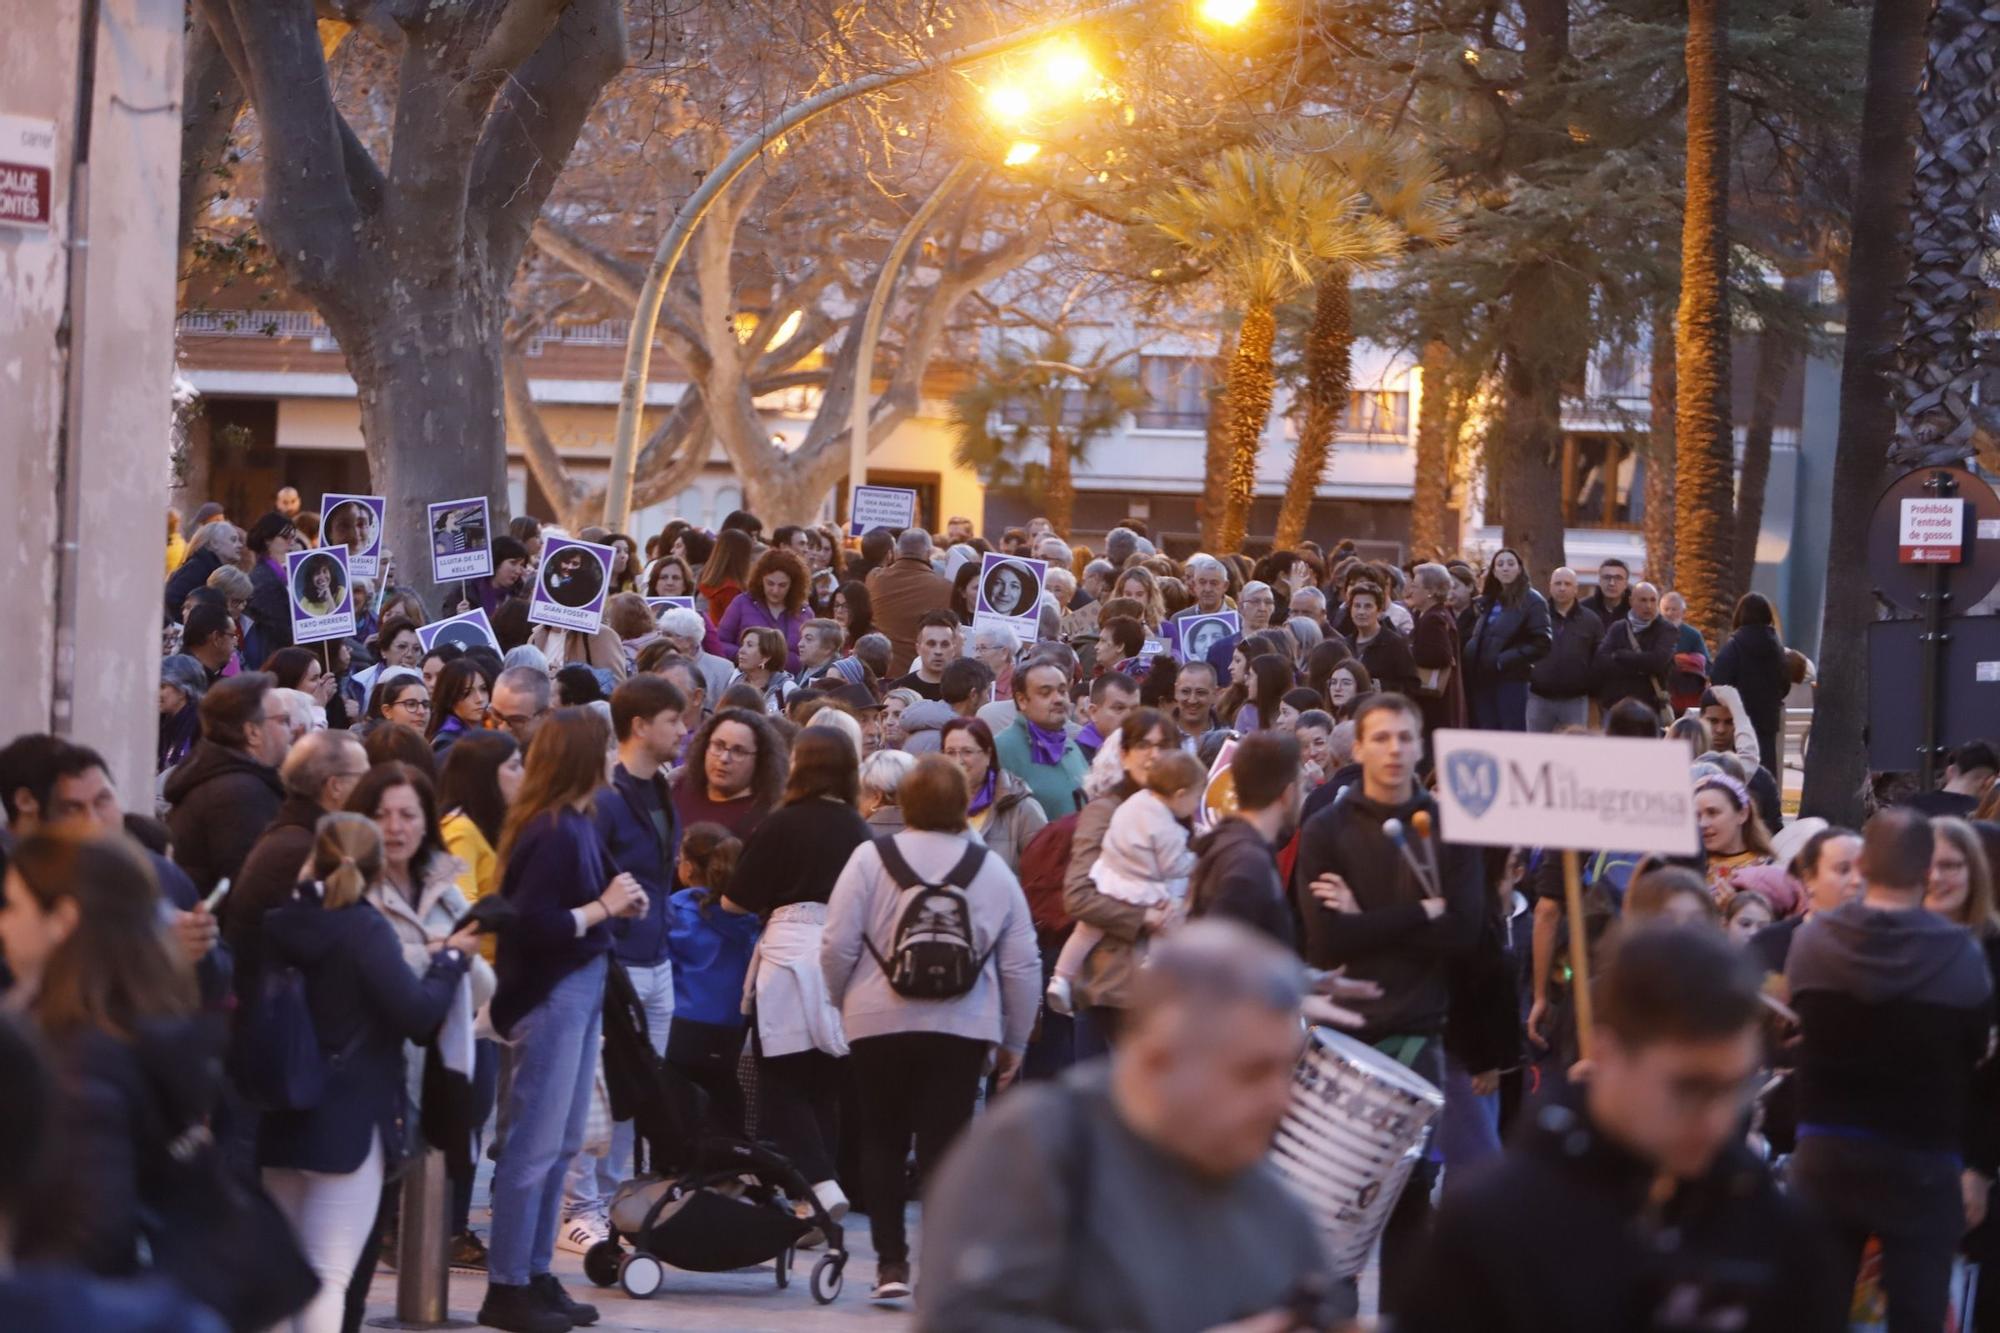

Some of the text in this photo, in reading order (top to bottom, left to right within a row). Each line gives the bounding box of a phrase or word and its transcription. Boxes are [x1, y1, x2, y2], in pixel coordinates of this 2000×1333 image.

[1911, 504, 1953, 514] Prohibida
[1911, 517, 1952, 527] l'entrada
[1909, 530, 1953, 542] de gossos
[350, 557, 374, 565] GLESIAS
[543, 604, 589, 618] DIAN FOSSEY
[300, 615, 349, 628] YAYO HERRERO
[1508, 759, 1687, 822] Milagrosa
